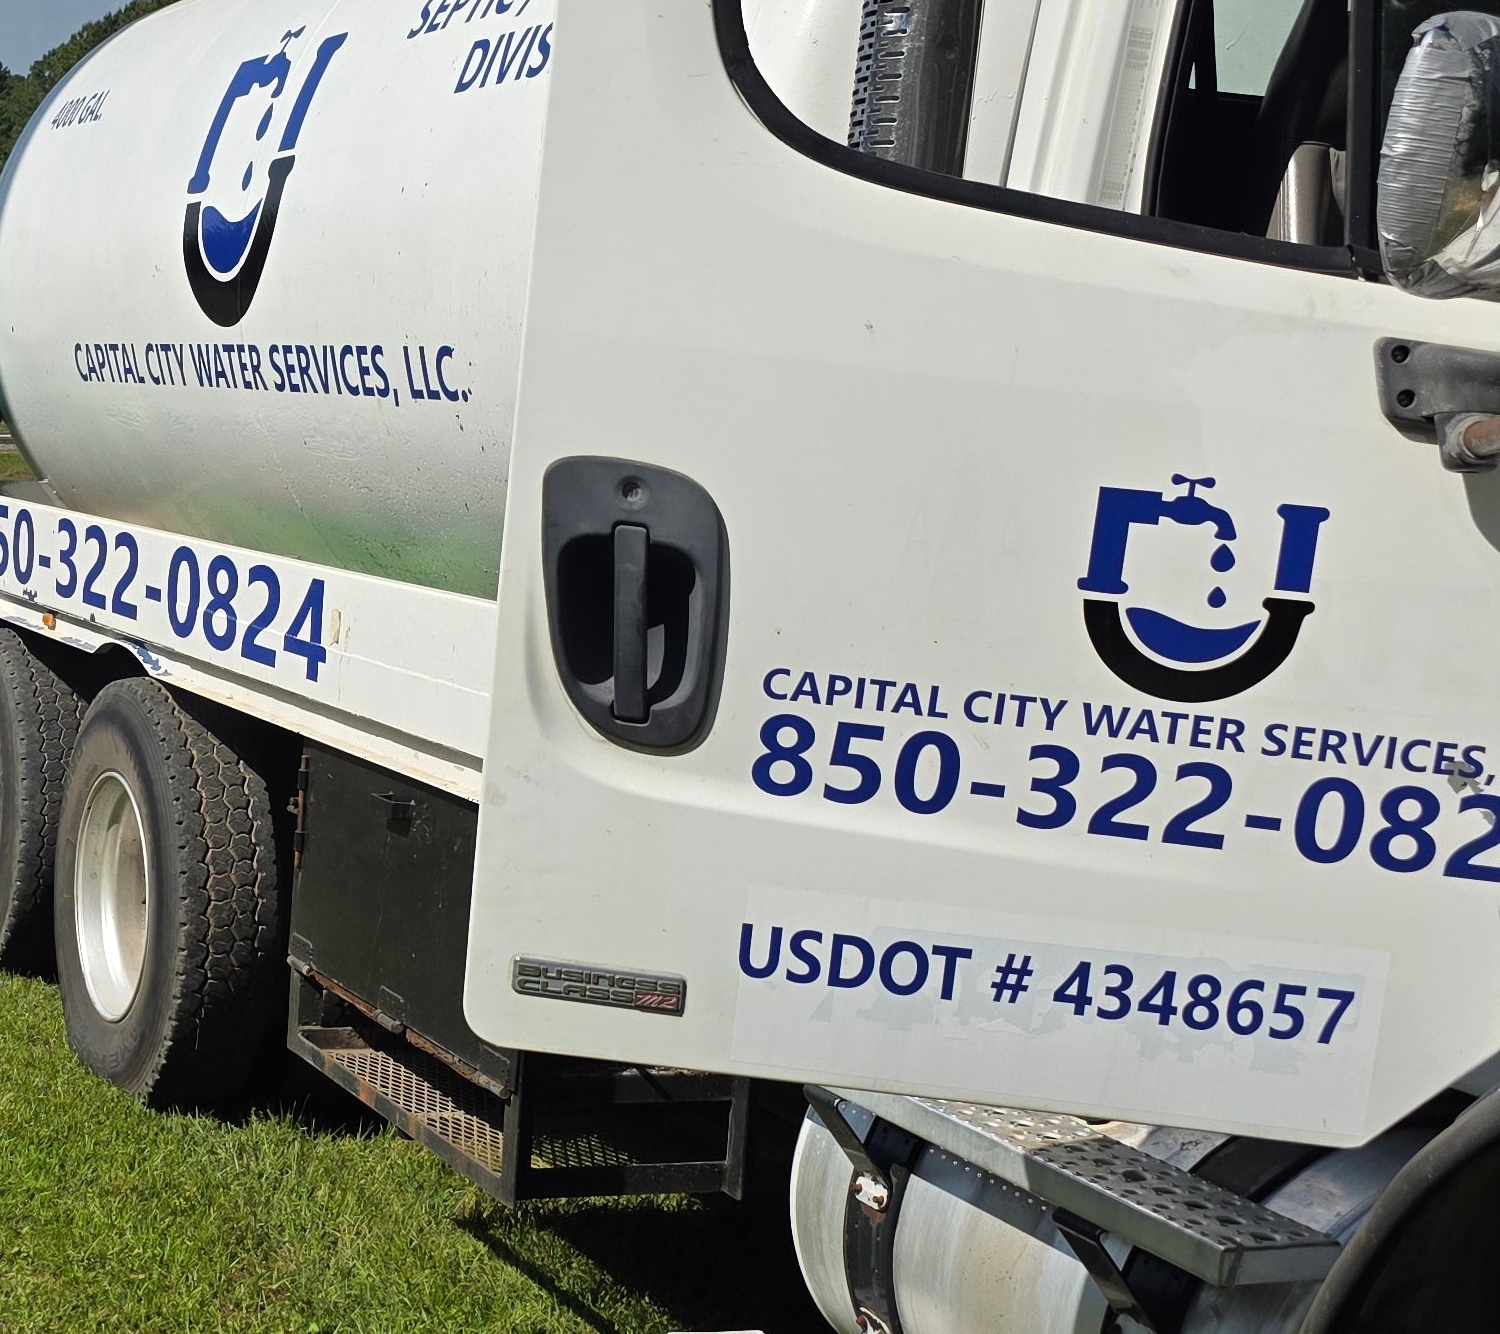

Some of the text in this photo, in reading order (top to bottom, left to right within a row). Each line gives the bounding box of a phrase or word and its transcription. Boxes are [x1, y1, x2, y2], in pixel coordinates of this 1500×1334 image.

[453, 21, 554, 94] DIVIS
[74, 342, 470, 407] CAPITAL CITY WATER SERVICES, LLC.
[762, 667, 1496, 787] CAPITAL CITY WATER SERVICES,
[751, 713, 1500, 883] 850-322-082
[516, 977, 635, 1005] CLASS
[517, 963, 681, 995] BUSINESS
[738, 923, 1356, 1046] USDOT # 4348657
